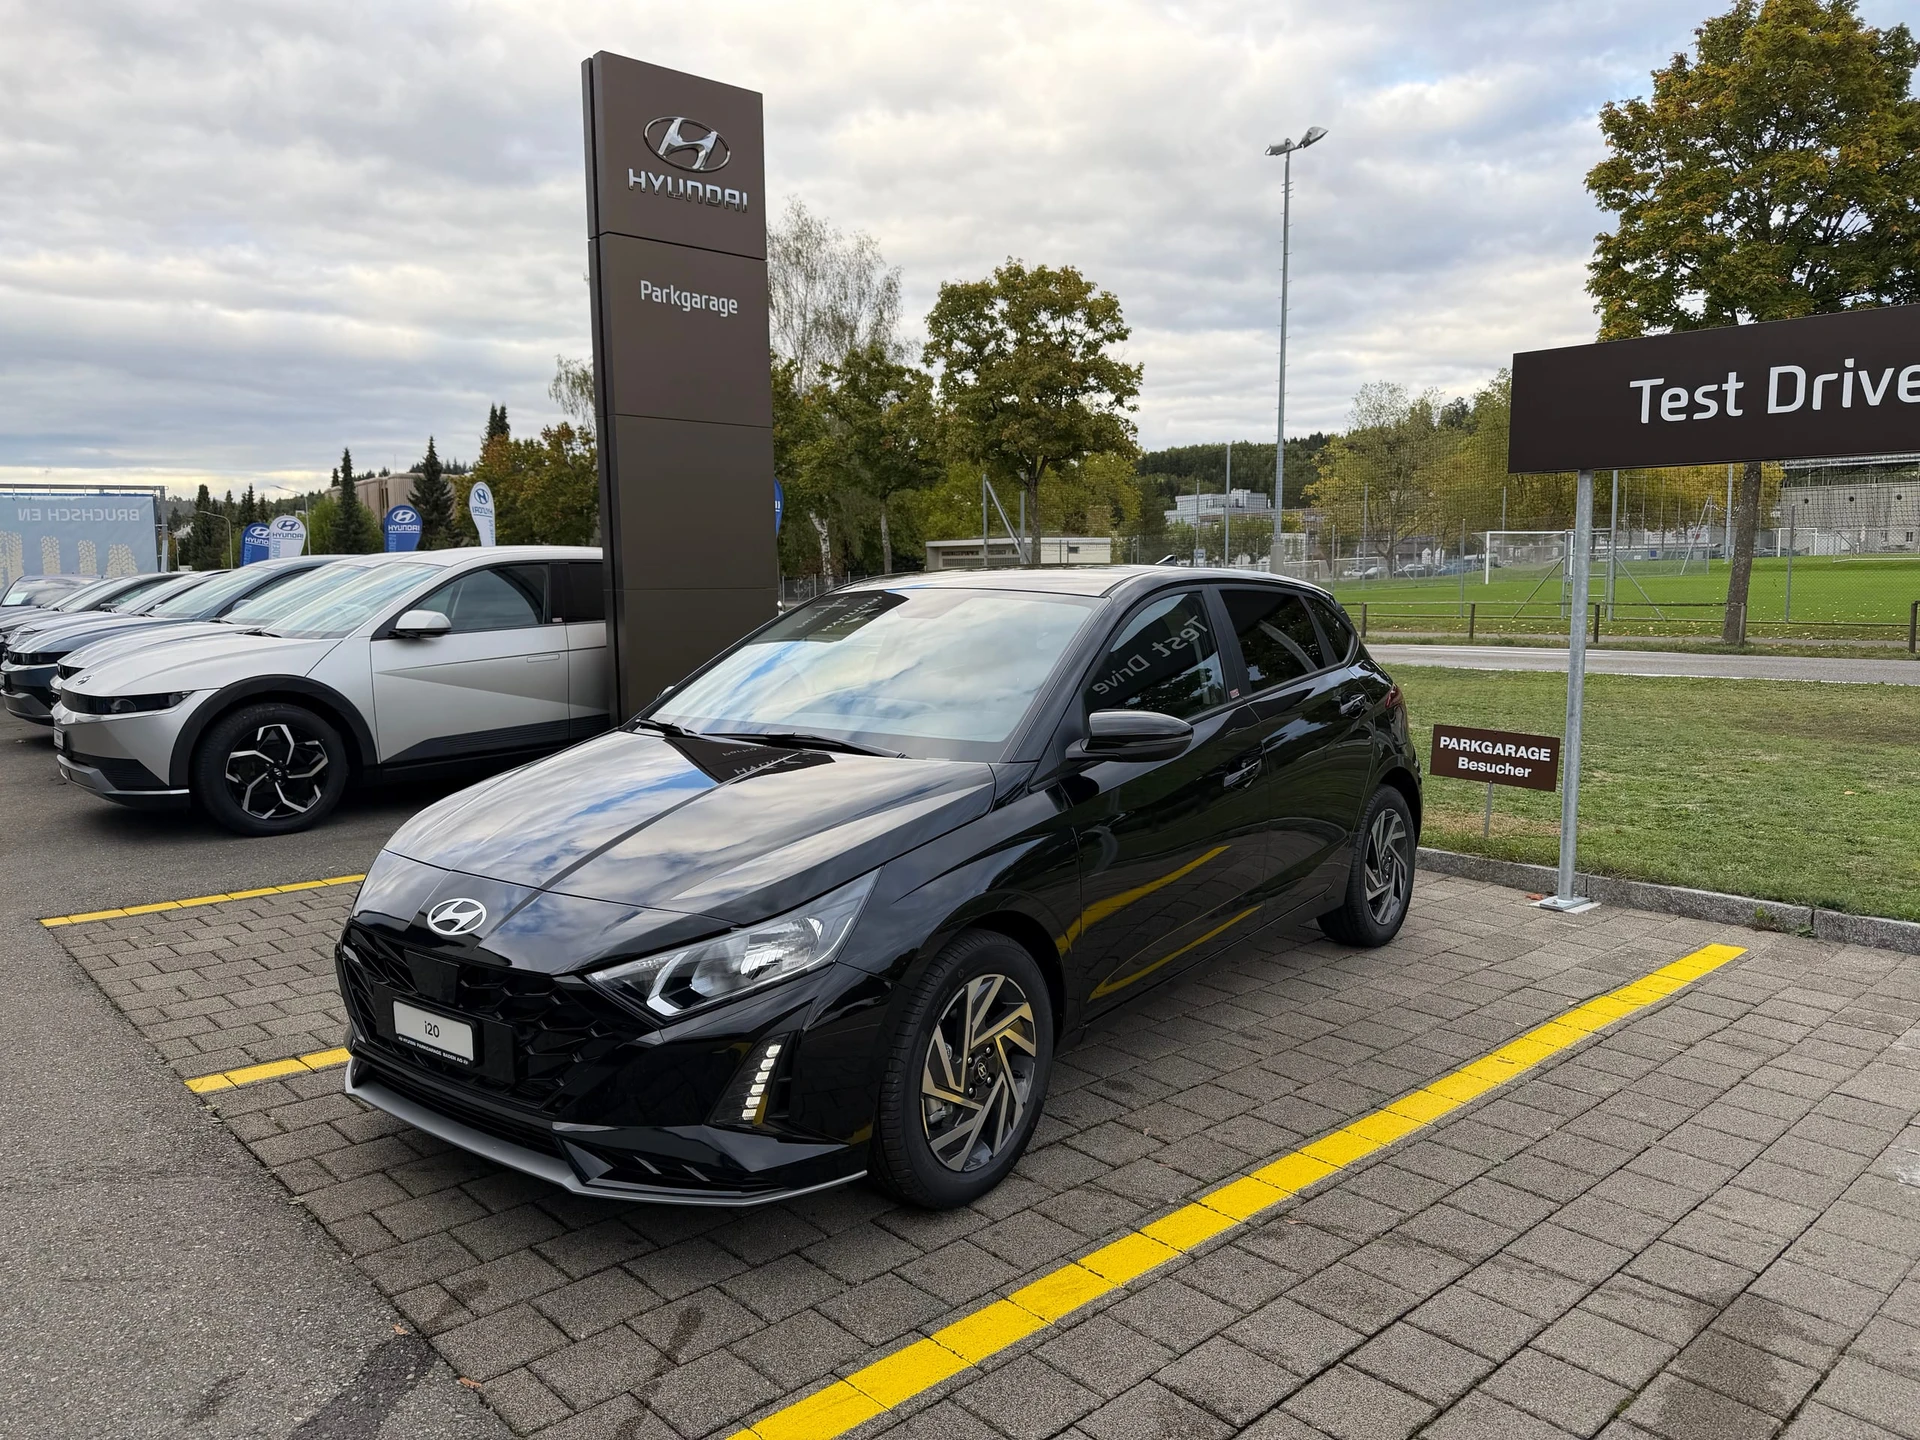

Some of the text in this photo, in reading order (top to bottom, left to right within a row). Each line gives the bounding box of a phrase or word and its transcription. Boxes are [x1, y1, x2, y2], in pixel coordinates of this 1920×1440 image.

[628, 168, 748, 213] HYUNDAI
[640, 280, 738, 317] Parkgarage
[1629, 358, 1920, 424] Test Drive
[388, 524, 421, 532] HYUNDAI
[245, 536, 269, 545] HYUND
[1439, 736, 1551, 761] PARKGARAGE
[1457, 756, 1532, 778] Besucher
[424, 1020, 440, 1038] i20
